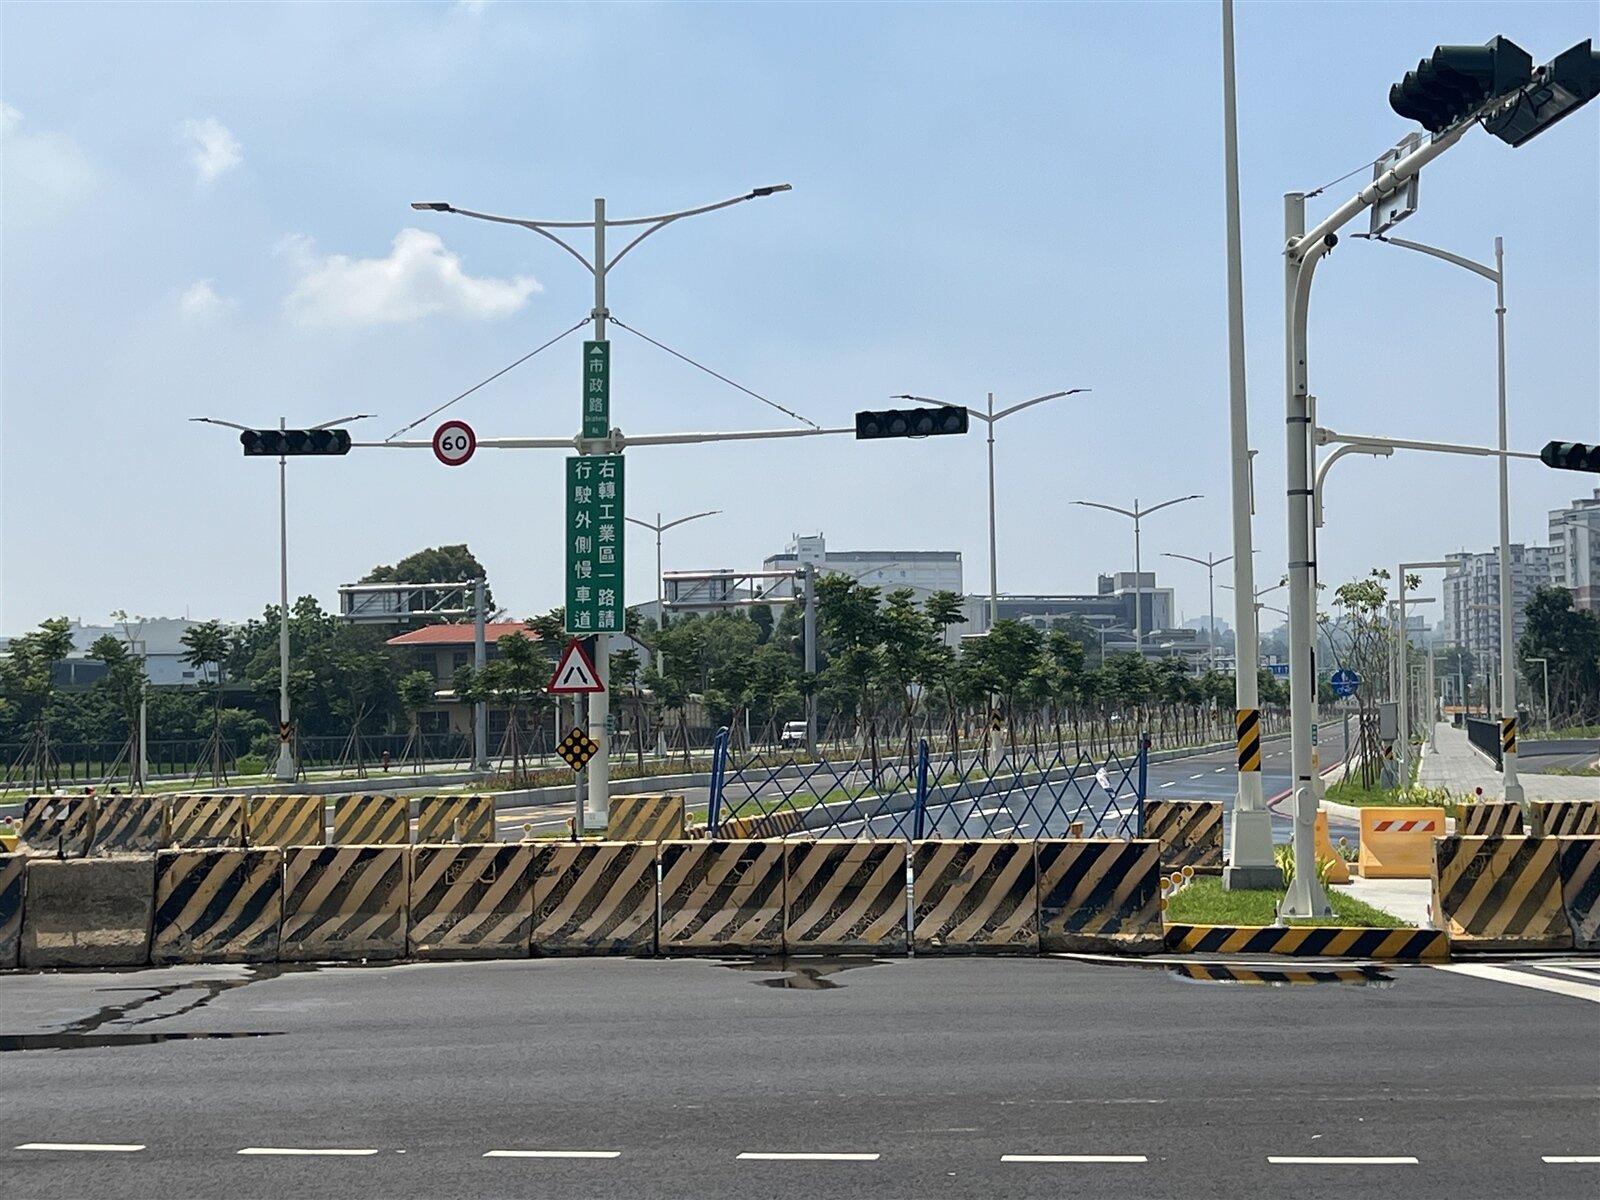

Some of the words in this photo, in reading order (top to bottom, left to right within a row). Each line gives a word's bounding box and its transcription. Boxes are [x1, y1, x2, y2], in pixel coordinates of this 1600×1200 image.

[589, 359, 603, 412] 市政路
[442, 435, 467, 451] 60
[574, 461, 592, 629] 行駛外側慢車道
[598, 460, 615, 628] 右轉工業區一路請
